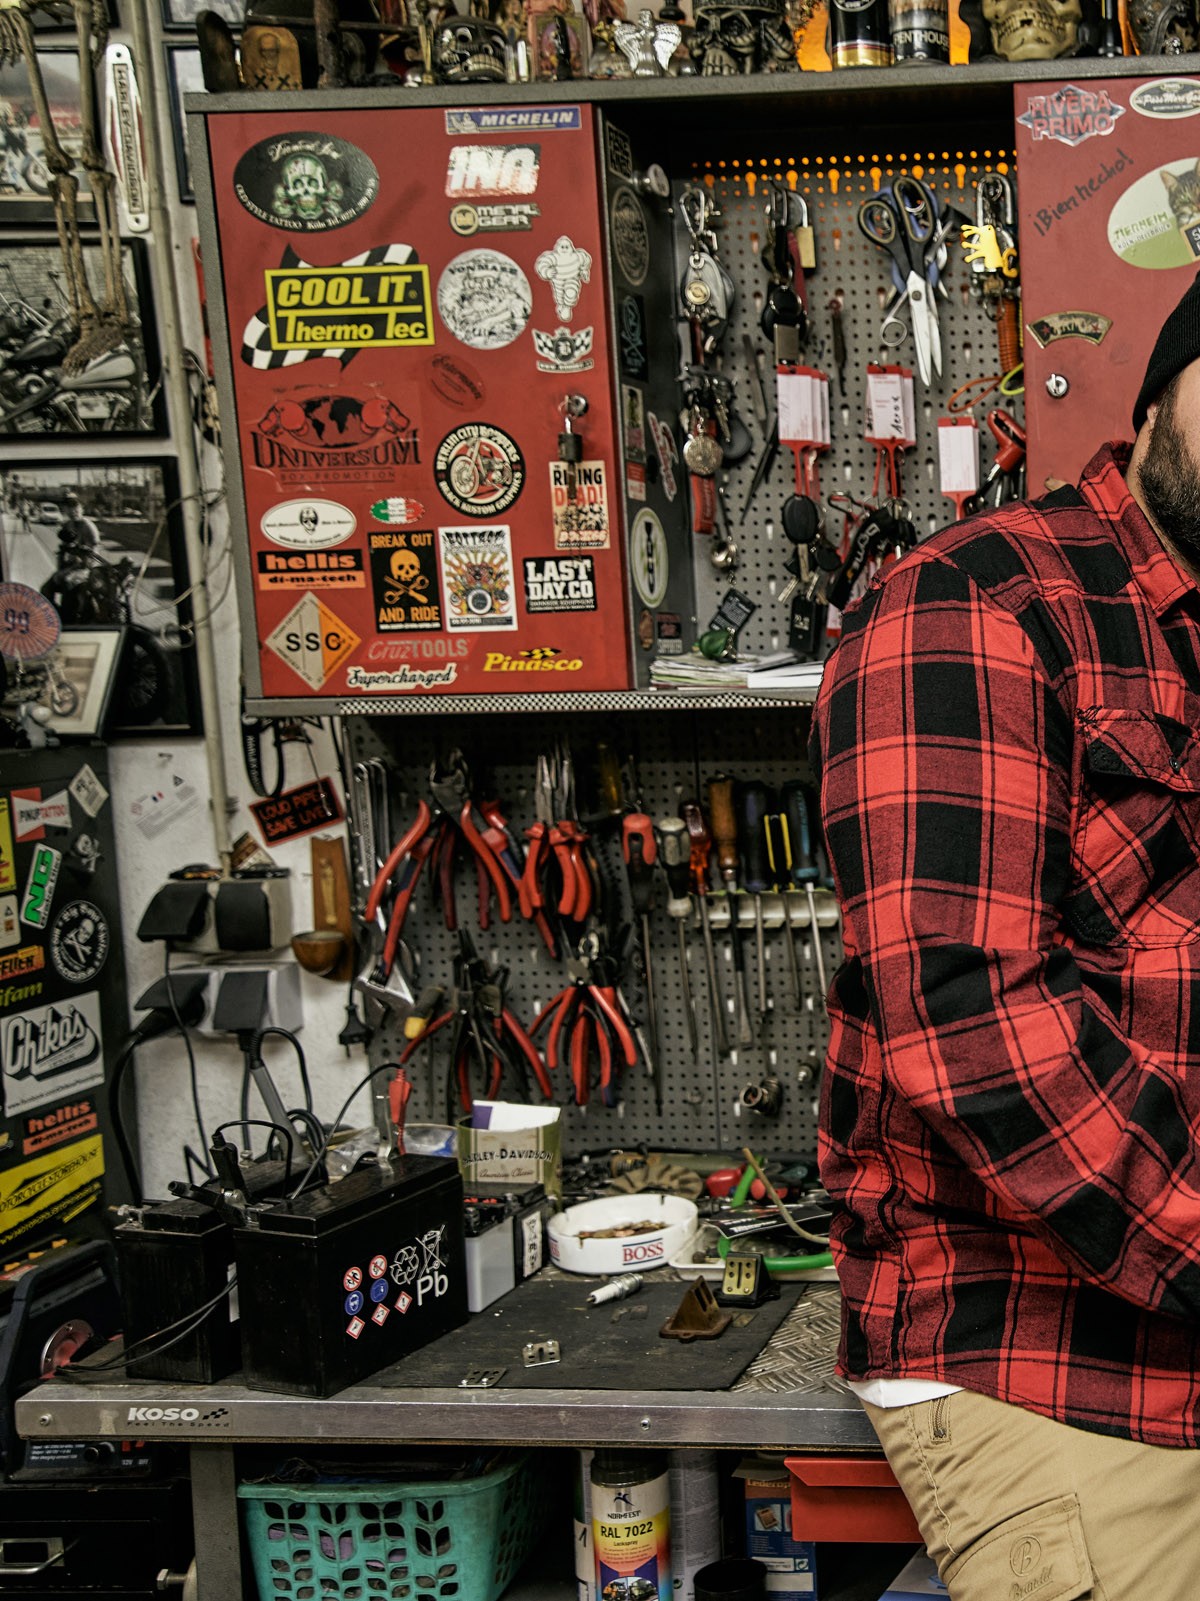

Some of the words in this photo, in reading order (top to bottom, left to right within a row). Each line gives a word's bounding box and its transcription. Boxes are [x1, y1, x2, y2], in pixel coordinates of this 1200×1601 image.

[1030, 93, 1113, 117] RIVERA
[480, 111, 575, 127] MICHELIN
[1032, 114, 1113, 139] PRIMO
[115, 68, 142, 210] HARLEY-DAVIDSON
[475, 204, 540, 217] METAL
[478, 215, 530, 227] GEAR
[276, 277, 373, 307] COOL
[378, 275, 412, 303] IT
[276, 311, 375, 343] Thermo
[384, 309, 427, 340] Tec
[250, 428, 422, 469] UNIVERSUM
[553, 467, 603, 486] RIING
[494, 471, 523, 511] GRAPHICS
[554, 485, 604, 508] DAD!
[370, 534, 407, 549] BREAK
[411, 532, 433, 547] OUT
[265, 552, 357, 571] hellis
[525, 558, 592, 583] LAST
[268, 573, 357, 585] di-ma-tech
[527, 580, 594, 601] DAY.CO
[378, 606, 406, 624] AND
[411, 605, 441, 622] RIDE
[483, 652, 584, 673] Pinasco
[348, 666, 454, 688] Supercharged
[27, 1100, 91, 1134] hellis
[622, 1241, 665, 1263] BOSS
[416, 1270, 449, 1306] Pb
[128, 1407, 200, 1421] KOSO
[600, 1523, 622, 1539] RAL
[624, 1520, 654, 1538] 7022
